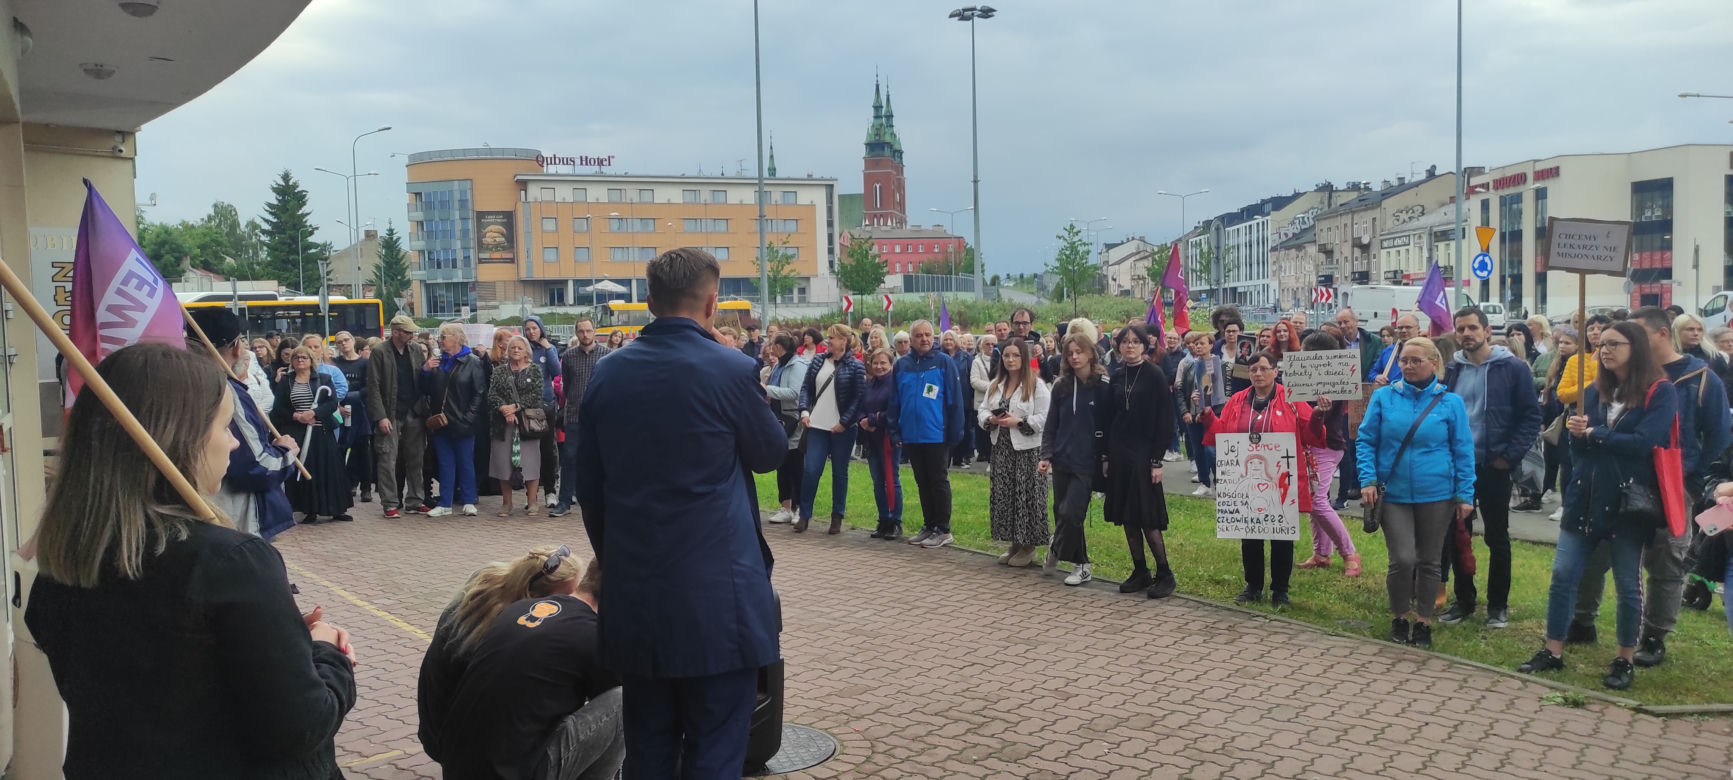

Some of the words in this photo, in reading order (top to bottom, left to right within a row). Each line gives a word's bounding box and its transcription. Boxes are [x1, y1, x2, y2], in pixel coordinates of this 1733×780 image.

[535, 153, 576, 168] Qubus
[580, 155, 611, 167] Hotel
[1492, 172, 1528, 191] BODZIO
[1558, 232, 1597, 242] CHCEMY
[1557, 243, 1600, 252] LEKARZY
[1602, 245, 1618, 253] NIE
[1556, 251, 1615, 262] MISJONARZY
[51, 261, 75, 337] ZŁO
[98, 255, 159, 357] LEWI
[1224, 439, 1240, 458] Jej
[1216, 459, 1240, 467] OFIARA
[1272, 526, 1296, 535] IURIS
